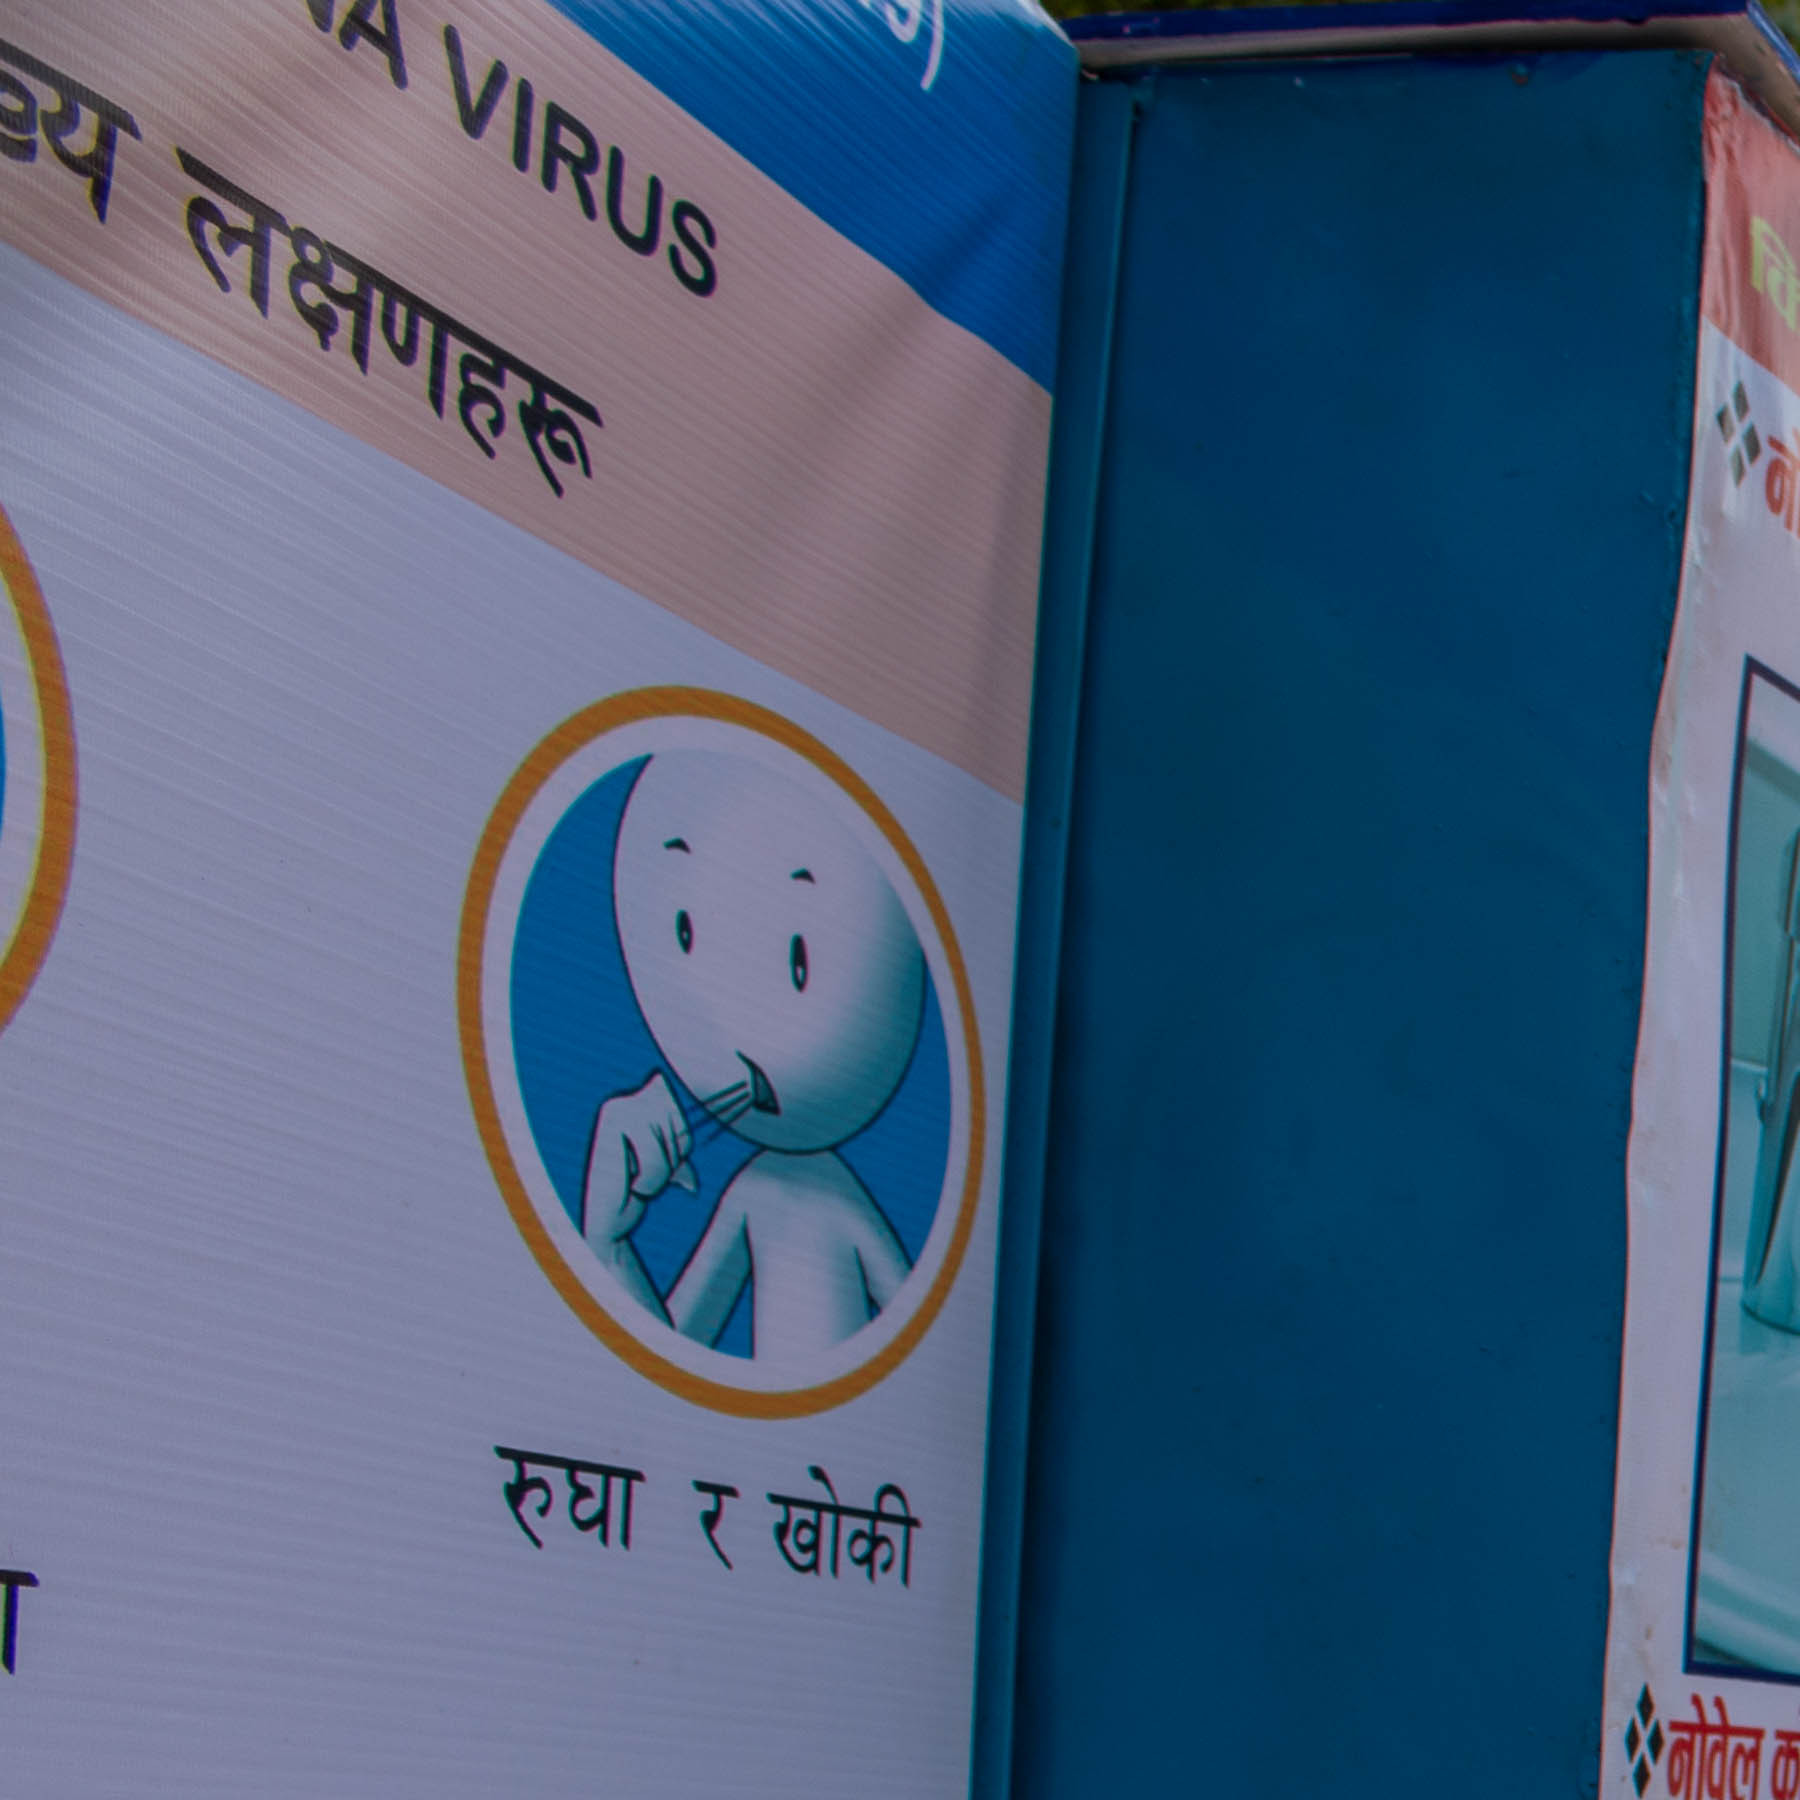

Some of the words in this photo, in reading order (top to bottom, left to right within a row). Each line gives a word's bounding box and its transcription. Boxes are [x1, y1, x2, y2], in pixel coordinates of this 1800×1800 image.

[444, 24, 717, 297] VIRUS
[174, 144, 604, 498] लक्षणहरू
[494, 1445, 645, 1550] रुघा
[692, 1479, 740, 1571] र
[766, 1465, 923, 1588] खोकी
